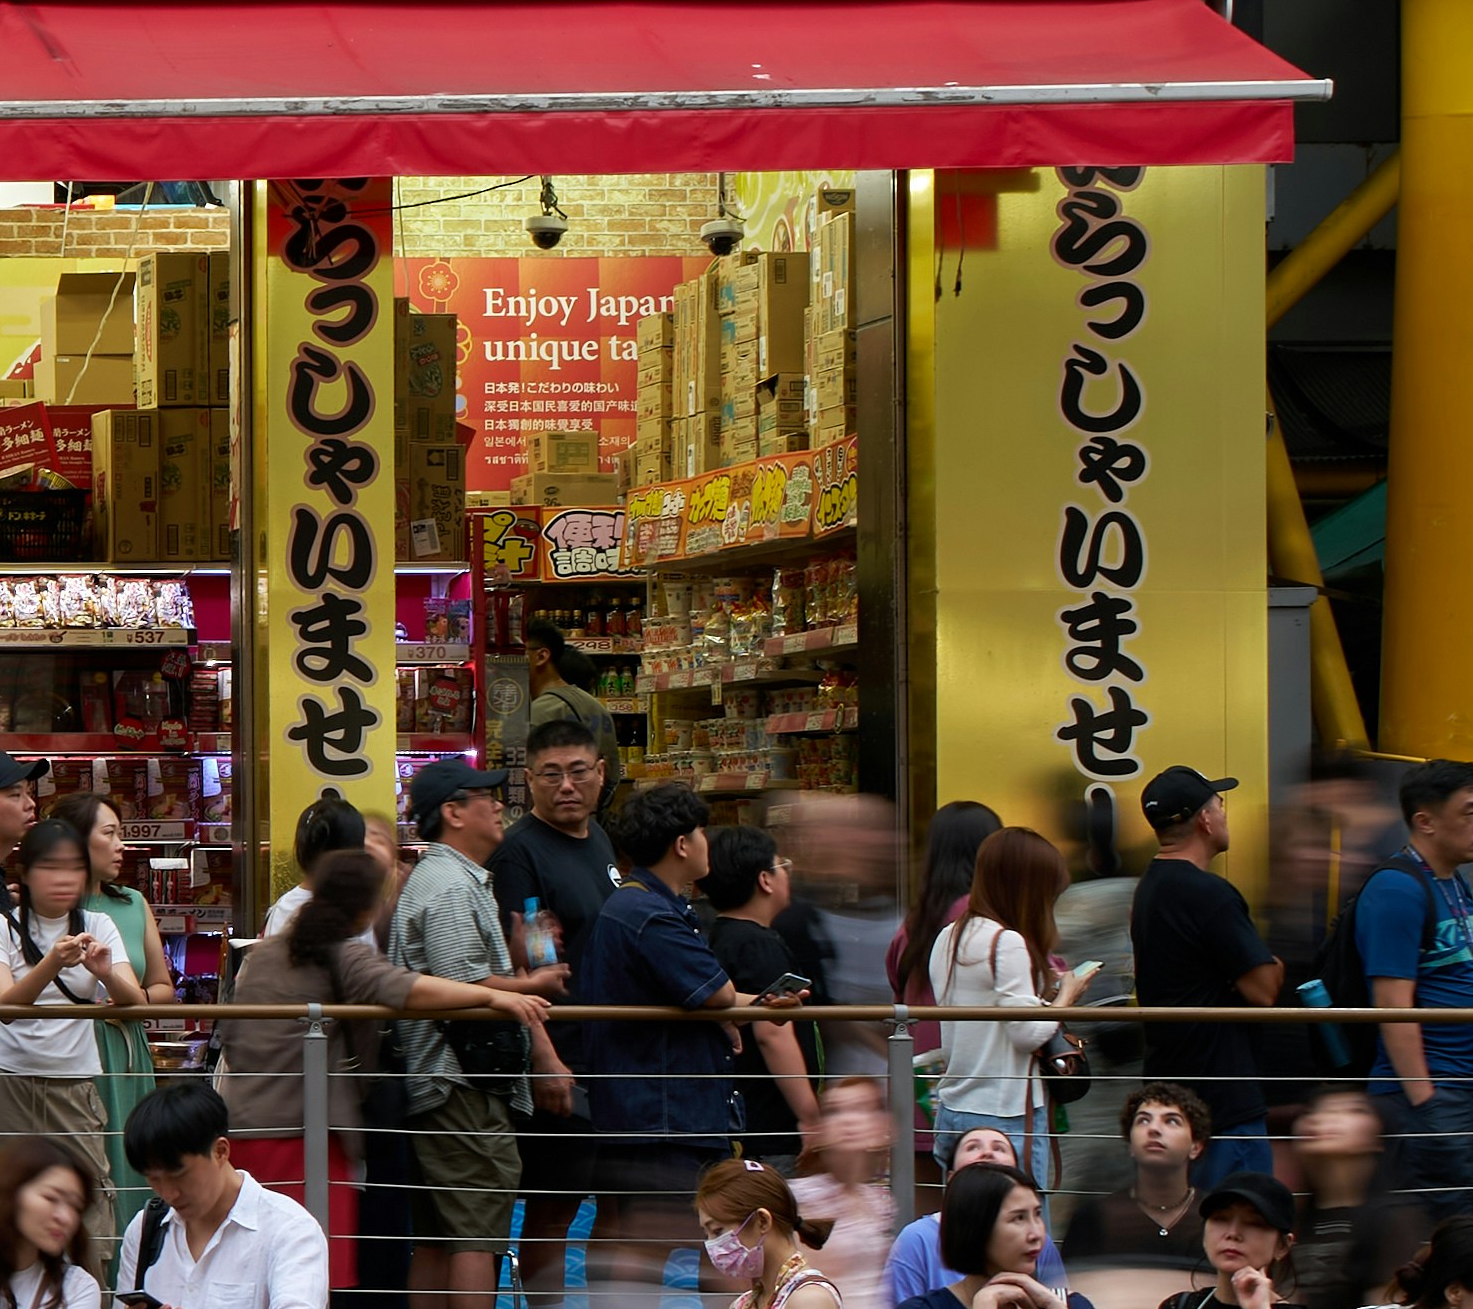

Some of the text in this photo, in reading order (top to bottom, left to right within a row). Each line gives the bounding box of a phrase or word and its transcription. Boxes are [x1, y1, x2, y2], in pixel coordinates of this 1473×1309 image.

[483, 288, 578, 327] Enjoy
[483, 332, 599, 370] unique
[284, 182, 380, 798] らっしゃいませ
